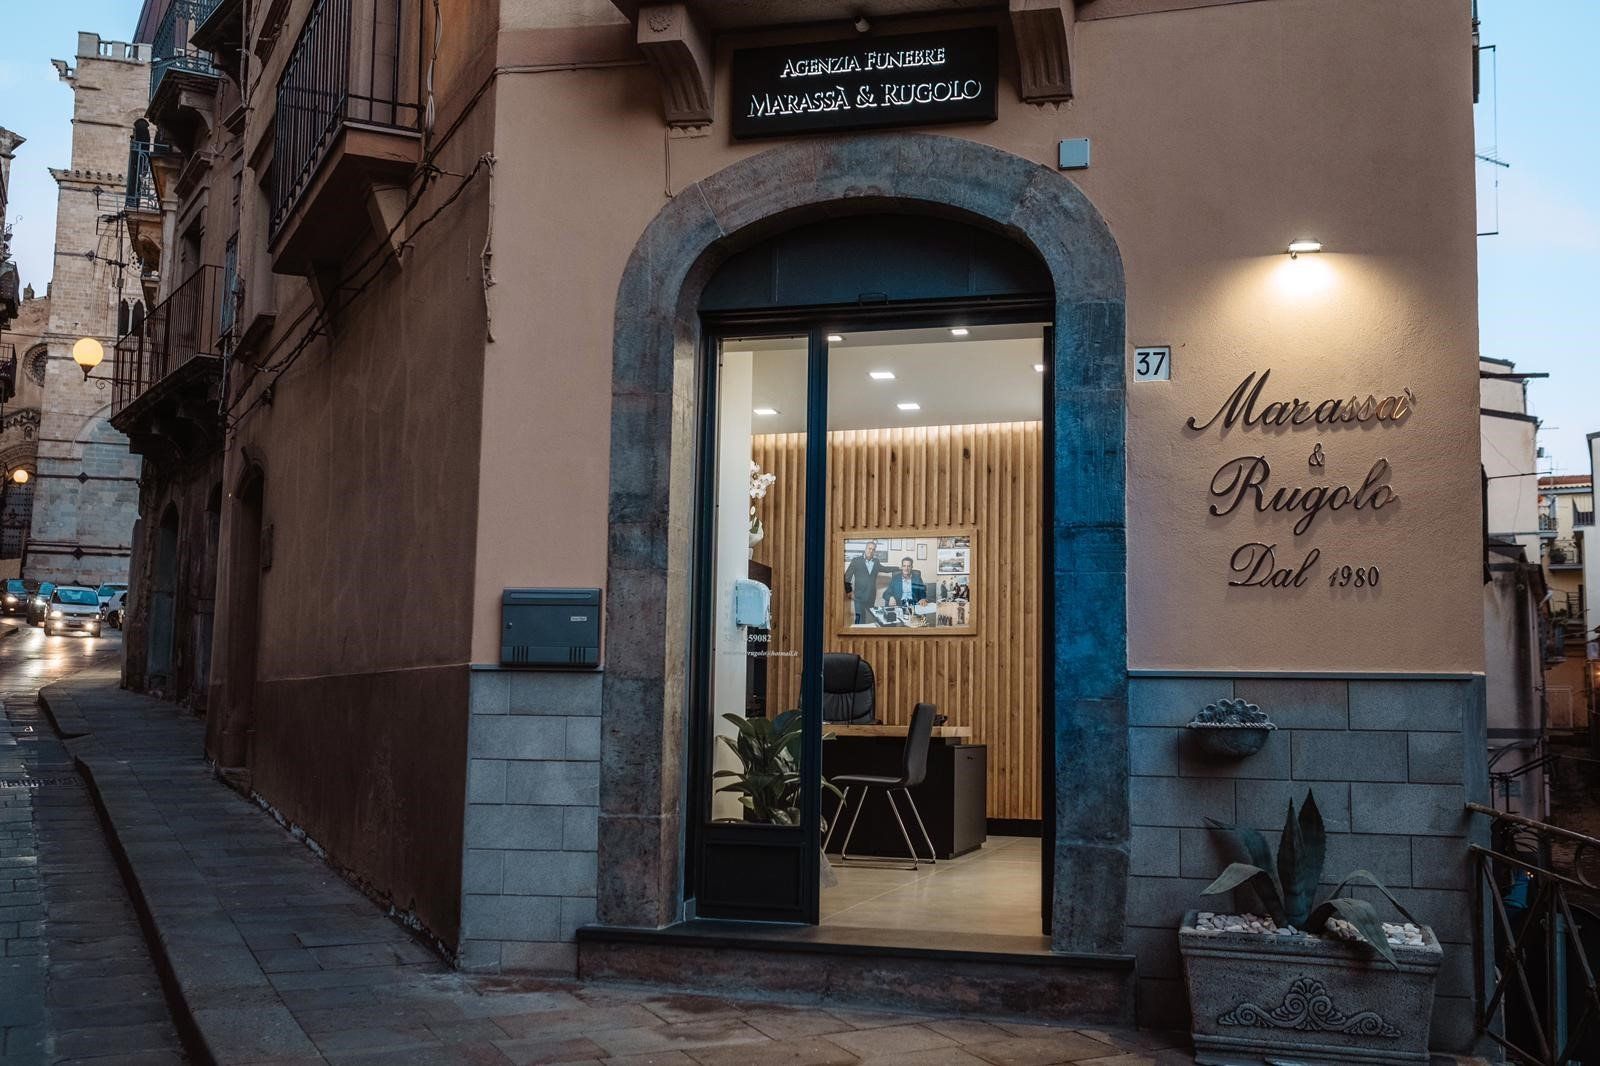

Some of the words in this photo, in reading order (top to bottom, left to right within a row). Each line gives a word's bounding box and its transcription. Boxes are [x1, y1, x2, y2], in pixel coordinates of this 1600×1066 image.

[780, 55, 860, 78] AGENZIA
[864, 47, 946, 70] FUNEBRE
[747, 86, 851, 118] MARASSÀ
[855, 84, 877, 108] &
[880, 79, 982, 105] RUGOLO
[1136, 351, 1167, 376] 37
[1308, 442, 1325, 468] &
[1209, 455, 1400, 536] Rugolo
[1228, 541, 1321, 588] Dal
[1328, 565, 1381, 588] 1980
